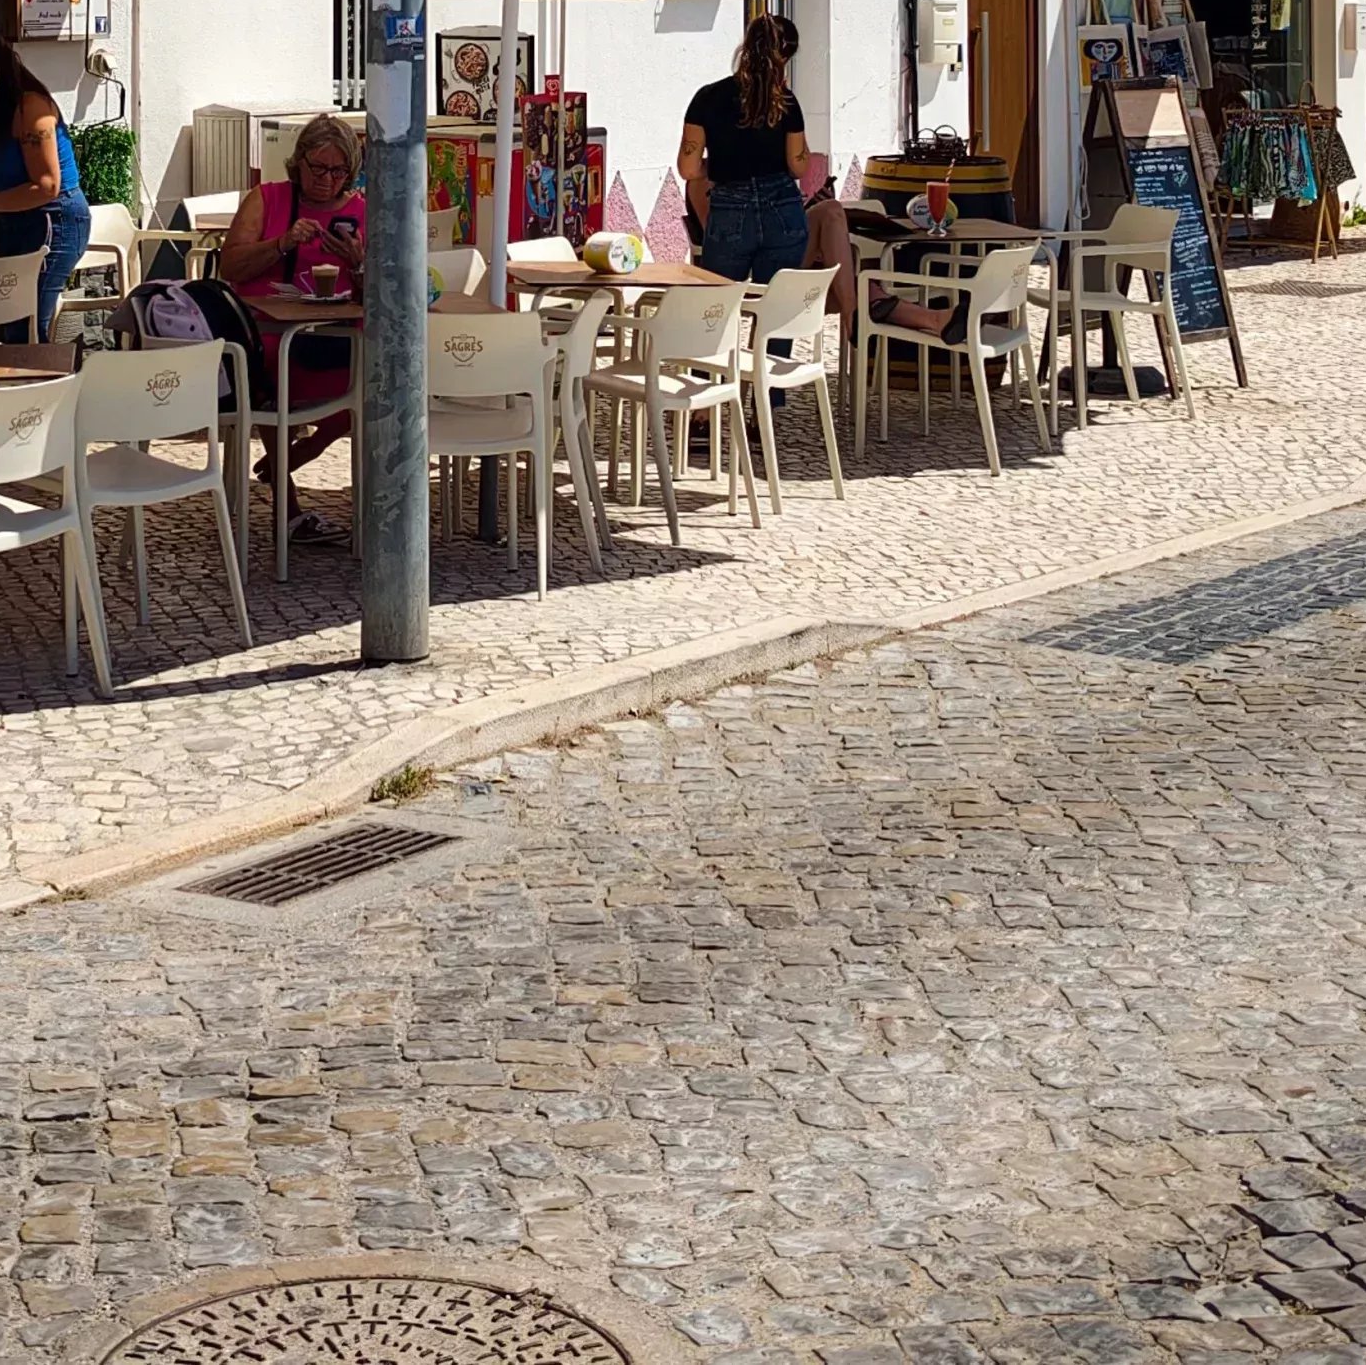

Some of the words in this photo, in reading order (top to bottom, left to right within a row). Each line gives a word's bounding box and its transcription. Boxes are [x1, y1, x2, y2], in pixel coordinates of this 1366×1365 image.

[444, 340, 484, 354] SAGRES
[145, 374, 181, 393] SAGRES
[9, 412, 43, 432] SAGRES
